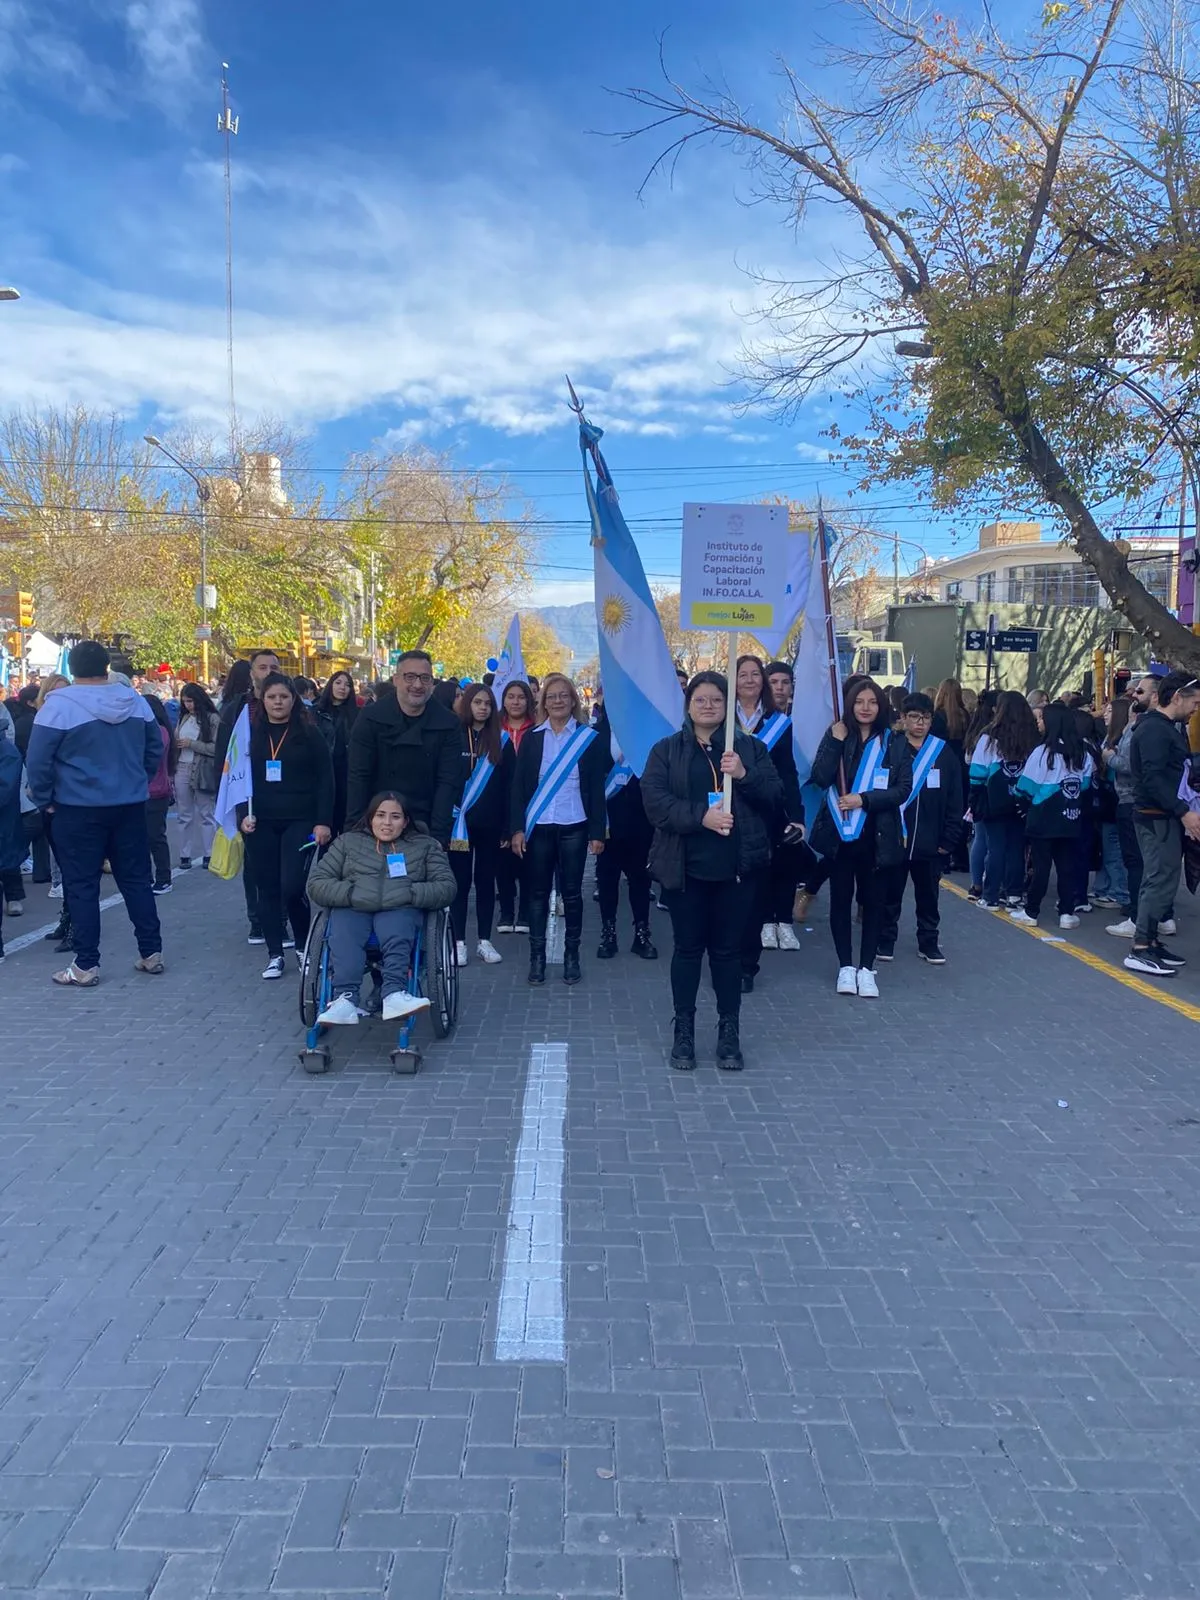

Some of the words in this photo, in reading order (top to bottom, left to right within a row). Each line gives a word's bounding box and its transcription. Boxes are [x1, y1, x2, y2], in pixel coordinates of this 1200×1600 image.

[706, 541, 749, 551] Instituto
[751, 542, 763, 551] de
[704, 553, 754, 563] Formación
[756, 556, 763, 565] y
[703, 564, 765, 575] Capacitación
[716, 576, 751, 586] Laboral
[702, 588, 763, 598] IN.FO.CA.LA.
[732, 607, 755, 621] Luján
